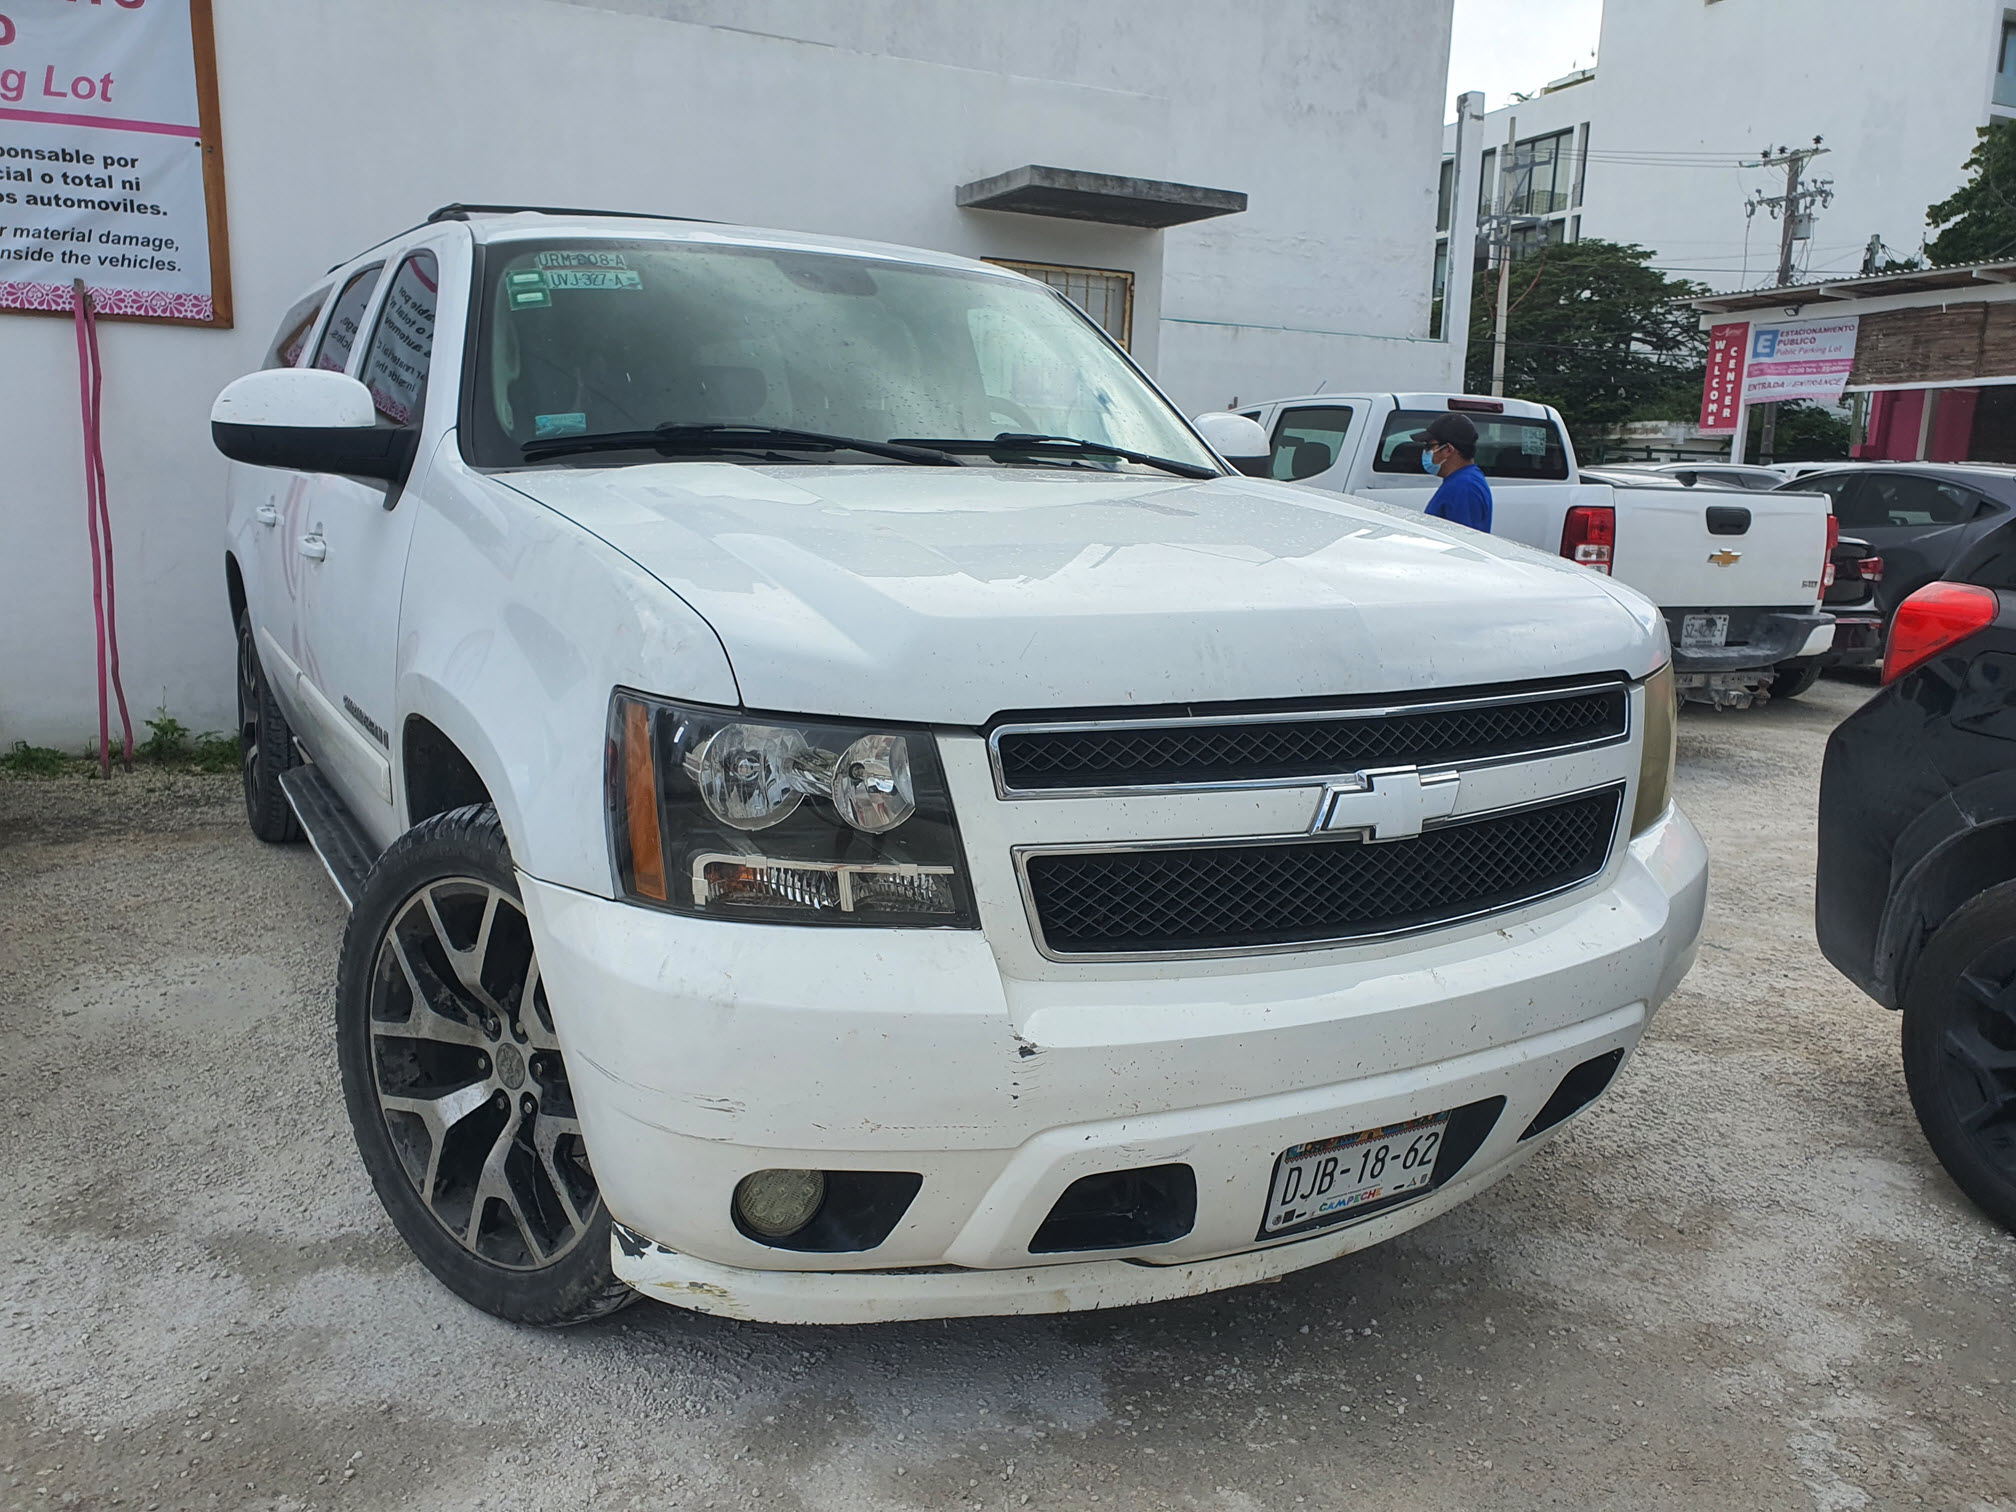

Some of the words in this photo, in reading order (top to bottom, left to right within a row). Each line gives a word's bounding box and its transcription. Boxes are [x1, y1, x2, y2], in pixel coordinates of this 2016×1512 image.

[43, 64, 114, 102] Lot
[103, 155, 139, 170] por
[41, 172, 54, 184] o
[61, 171, 113, 189] total
[121, 177, 141, 192] ni
[25, 193, 168, 216] automoviles.
[13, 225, 92, 243] material
[98, 230, 180, 253] damage,
[61, 249, 91, 266] the
[98, 253, 182, 272] vehicles.
[1780, 325, 1855, 338] ESTACIONAMIENTO
[1707, 340, 1726, 425] WELCOME
[1722, 347, 1738, 418] CENTER
[1748, 381, 1785, 391] ENTRADA
[1792, 378, 1844, 388] ENTRANCE
[1280, 1131, 1440, 1206] DJB-18-62
[1318, 1187, 1383, 1212] CAMPECHE
